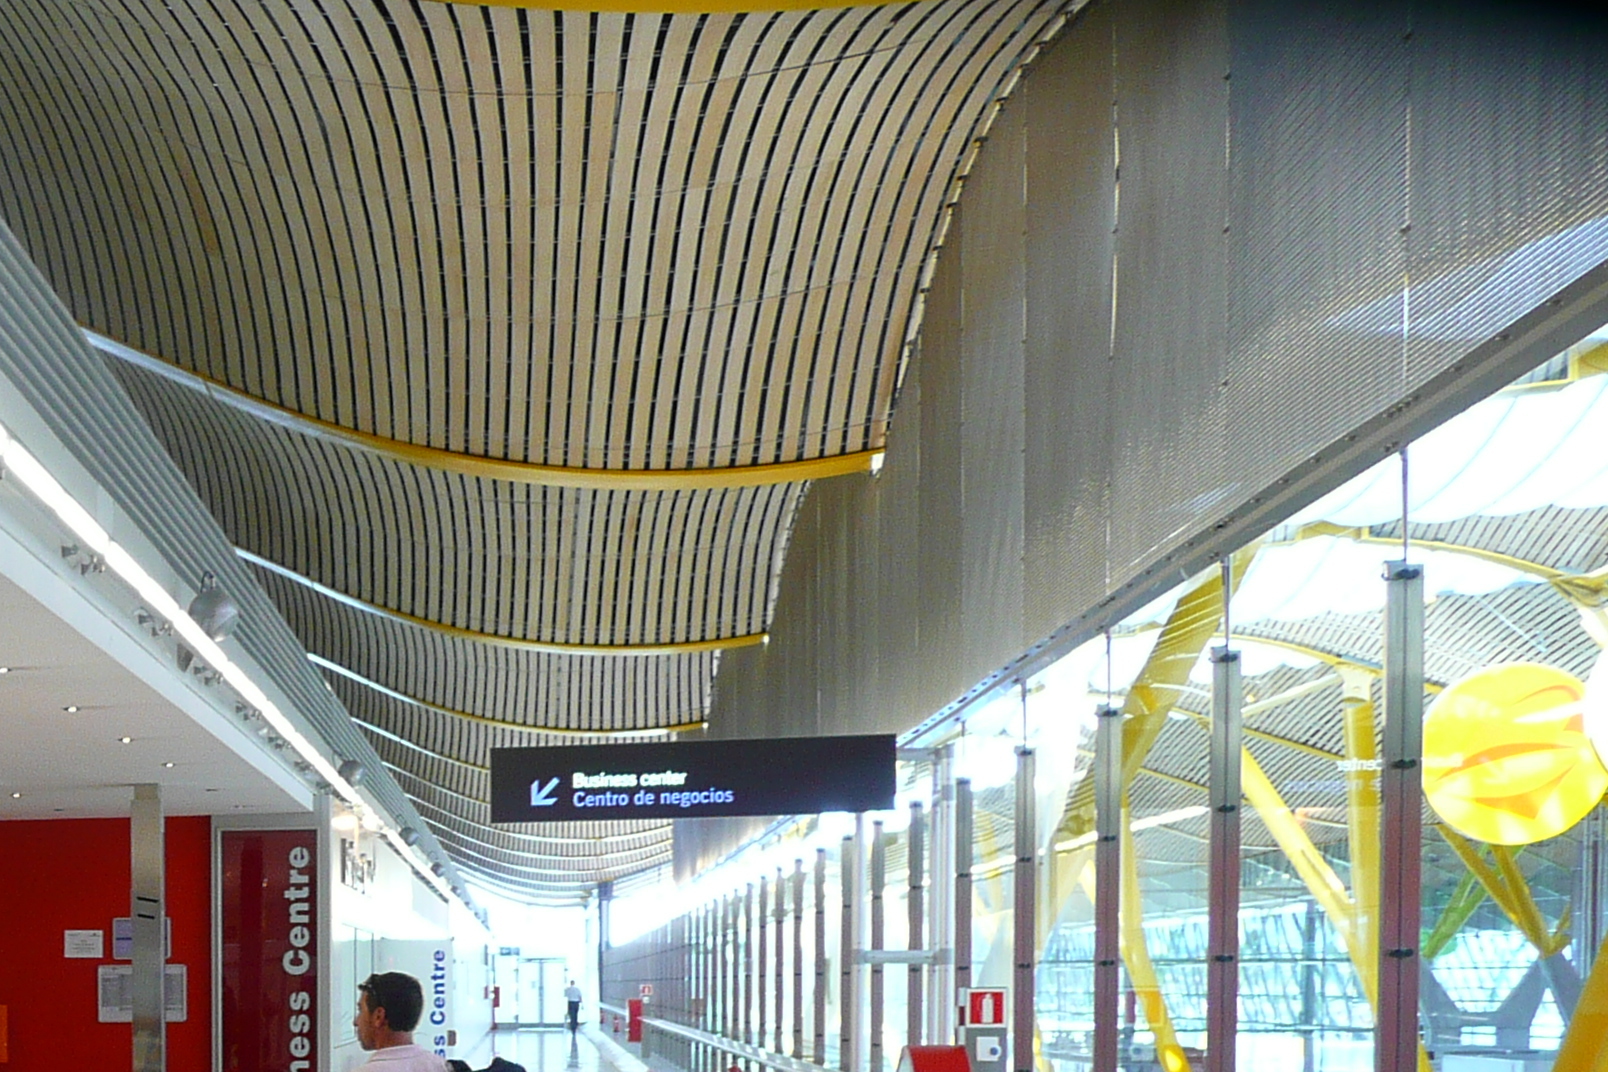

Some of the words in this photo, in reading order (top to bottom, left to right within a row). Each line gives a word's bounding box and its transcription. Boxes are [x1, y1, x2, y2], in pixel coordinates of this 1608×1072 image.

[572, 771, 638, 789] Business
[639, 770, 688, 787] center
[572, 791, 630, 808] Centro
[633, 789, 656, 806] de
[659, 787, 735, 808] negocios
[282, 846, 311, 976] Centre
[430, 949, 446, 1026] Centre
